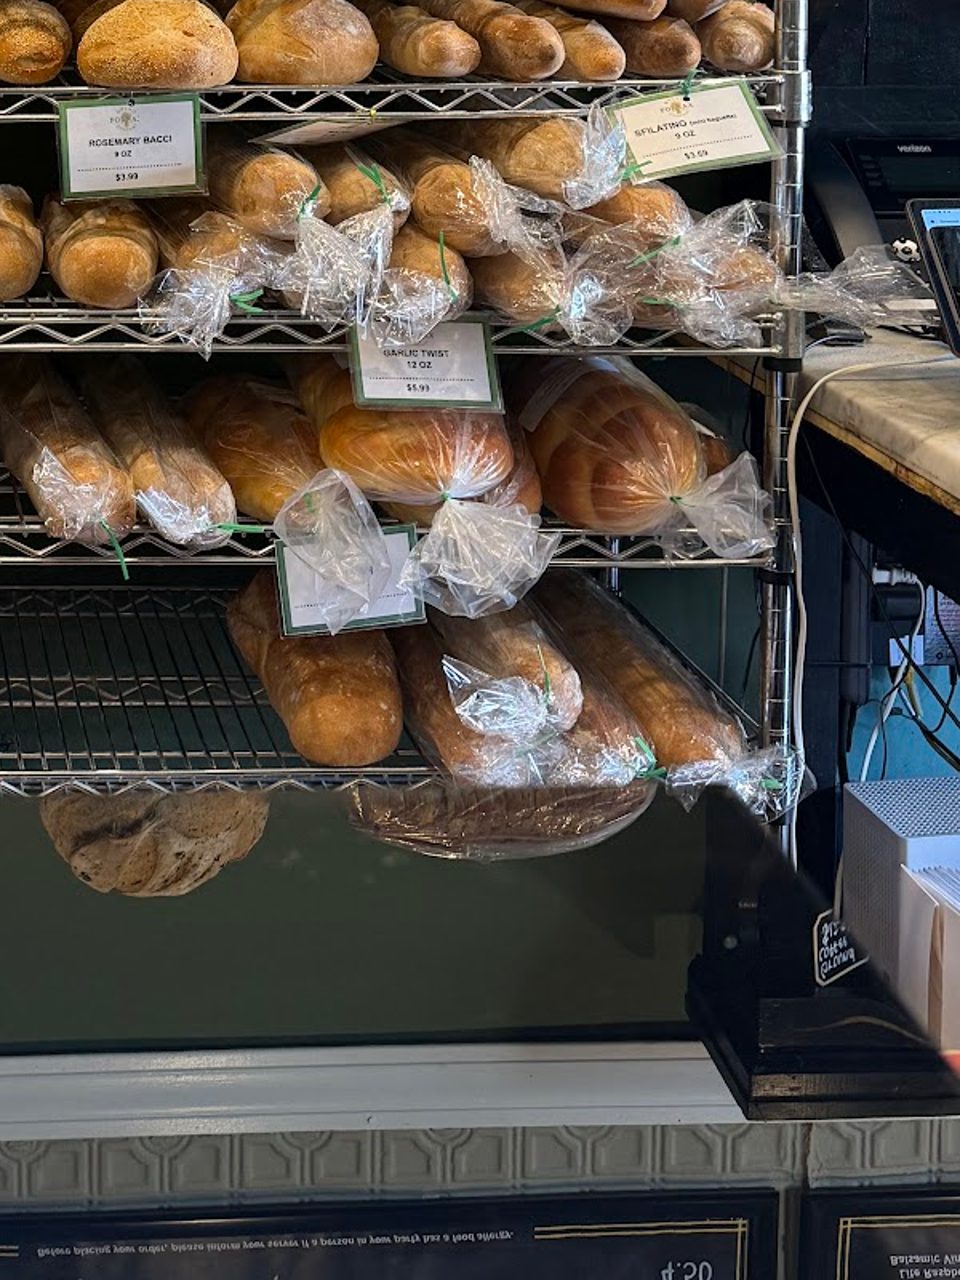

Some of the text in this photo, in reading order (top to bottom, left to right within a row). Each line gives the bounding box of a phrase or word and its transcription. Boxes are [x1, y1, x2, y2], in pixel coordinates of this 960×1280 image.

[634, 119, 688, 137] SFILATINO
[88, 134, 173, 148] ROSEMARY BACCI
[897, 144, 932, 152] verizon
[383, 350, 450, 358] GARLIC TWIST
[407, 360, 416, 368] 12
